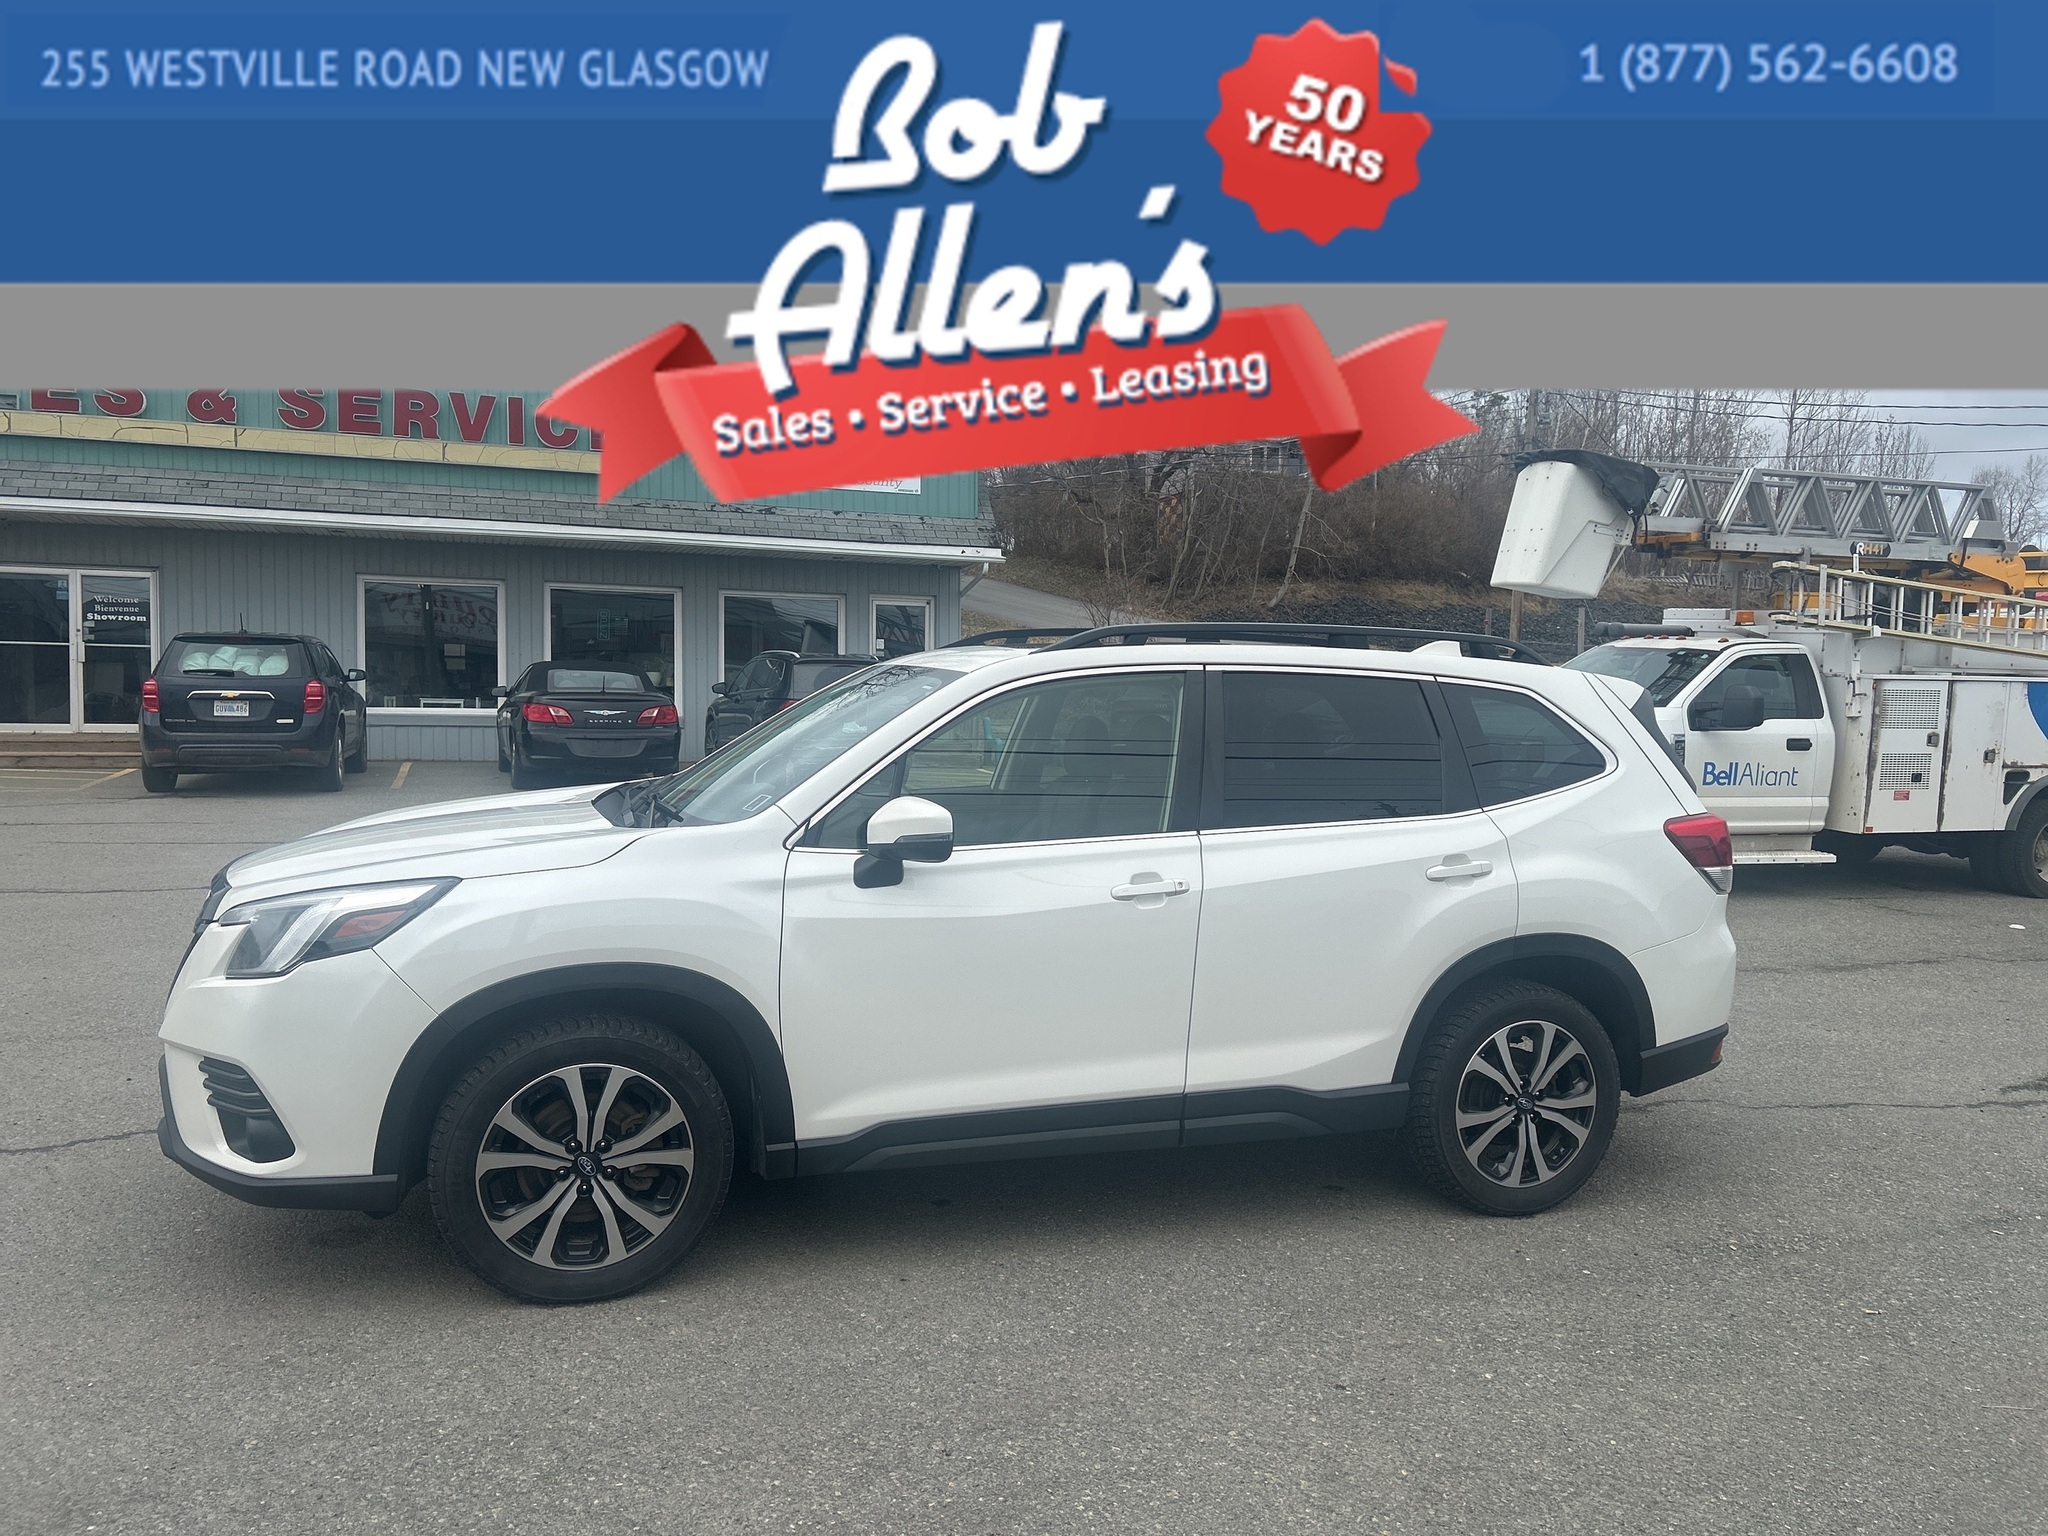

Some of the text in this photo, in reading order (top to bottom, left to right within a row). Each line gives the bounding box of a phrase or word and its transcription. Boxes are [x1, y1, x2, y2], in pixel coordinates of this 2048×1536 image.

[186, 388, 236, 424] &
[277, 388, 605, 452] SERVIC
[94, 595, 139, 603] Welcome
[94, 604, 140, 612] Bienvenue
[86, 612, 147, 621] Showroom
[235, 705, 248, 713] 486
